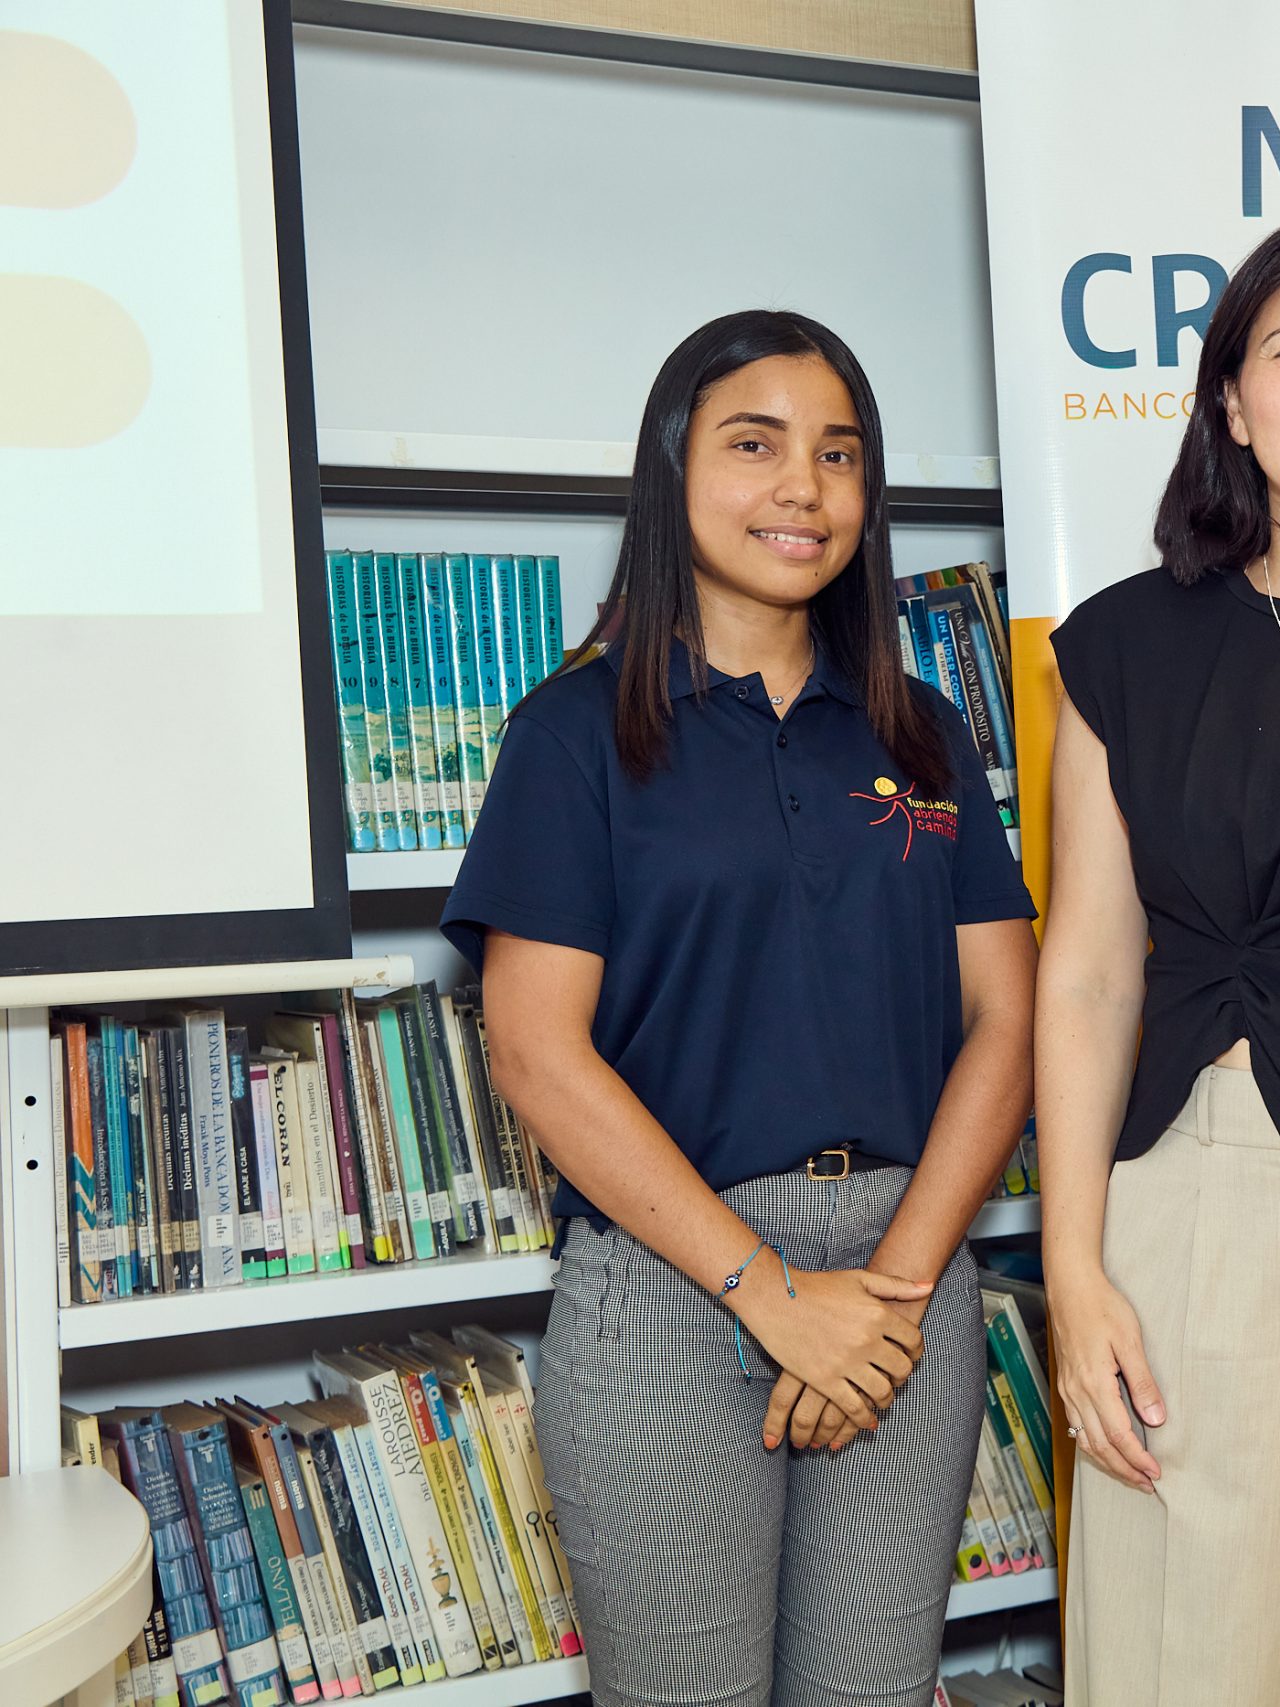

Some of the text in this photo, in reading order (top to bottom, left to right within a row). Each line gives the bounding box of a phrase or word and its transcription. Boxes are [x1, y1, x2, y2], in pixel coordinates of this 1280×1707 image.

[953, 611, 965, 630] UNA
[936, 615, 964, 710] UN LÍDER COMO
[963, 659, 978, 684] CON
[343, 677, 357, 688] 10
[369, 677, 378, 688] 9
[413, 678, 421, 688] 7
[439, 677, 447, 688] 6
[486, 676, 494, 687] 4
[507, 677, 515, 688] 3
[528, 677, 536, 686] 2
[967, 684, 992, 742] PROPÓSITO
[983, 751, 997, 770] WAR
[907, 797, 957, 814] fundación
[423, 993, 438, 1038] JUAN BOSCH
[403, 1011, 417, 1057] JUAN BOSCH
[176, 1064, 185, 1090] Antonio
[178, 1112, 189, 1149] inéditas
[276, 1100, 289, 1166] CORAN
[306, 1081, 326, 1197] anantiales en el Desierto
[498, 1133, 508, 1145] DEL
[95, 1129, 107, 1178] Introducción
[201, 1141, 210, 1165] Moya
[207, 1023, 234, 1275] PIONEROS DE LA BANCA DOMANA
[239, 1147, 247, 1166] CASA
[501, 1148, 513, 1170] JAPON
[509, 1133, 524, 1170] DEL JAPON
[181, 1150, 192, 1190] Décimas
[203, 1166, 212, 1187] Pons
[241, 1174, 249, 1195] VIAJE
[243, 1195, 249, 1205] EL
[369, 1384, 406, 1477] LAROUSSE
[415, 1416, 429, 1443] pasa?
[432, 1413, 447, 1439] pasa?
[385, 1379, 432, 1501] DEL AJEDREZ
[88, 1442, 96, 1465] ender
[446, 1449, 462, 1483] ESPAGNOL
[429, 1452, 444, 1485] ESPAGNOL
[273, 1479, 288, 1510] norma
[291, 1479, 305, 1510] norma
[335, 1509, 345, 1526] Entre
[378, 1566, 390, 1593] TDAH
[399, 1563, 412, 1591] TDAH
